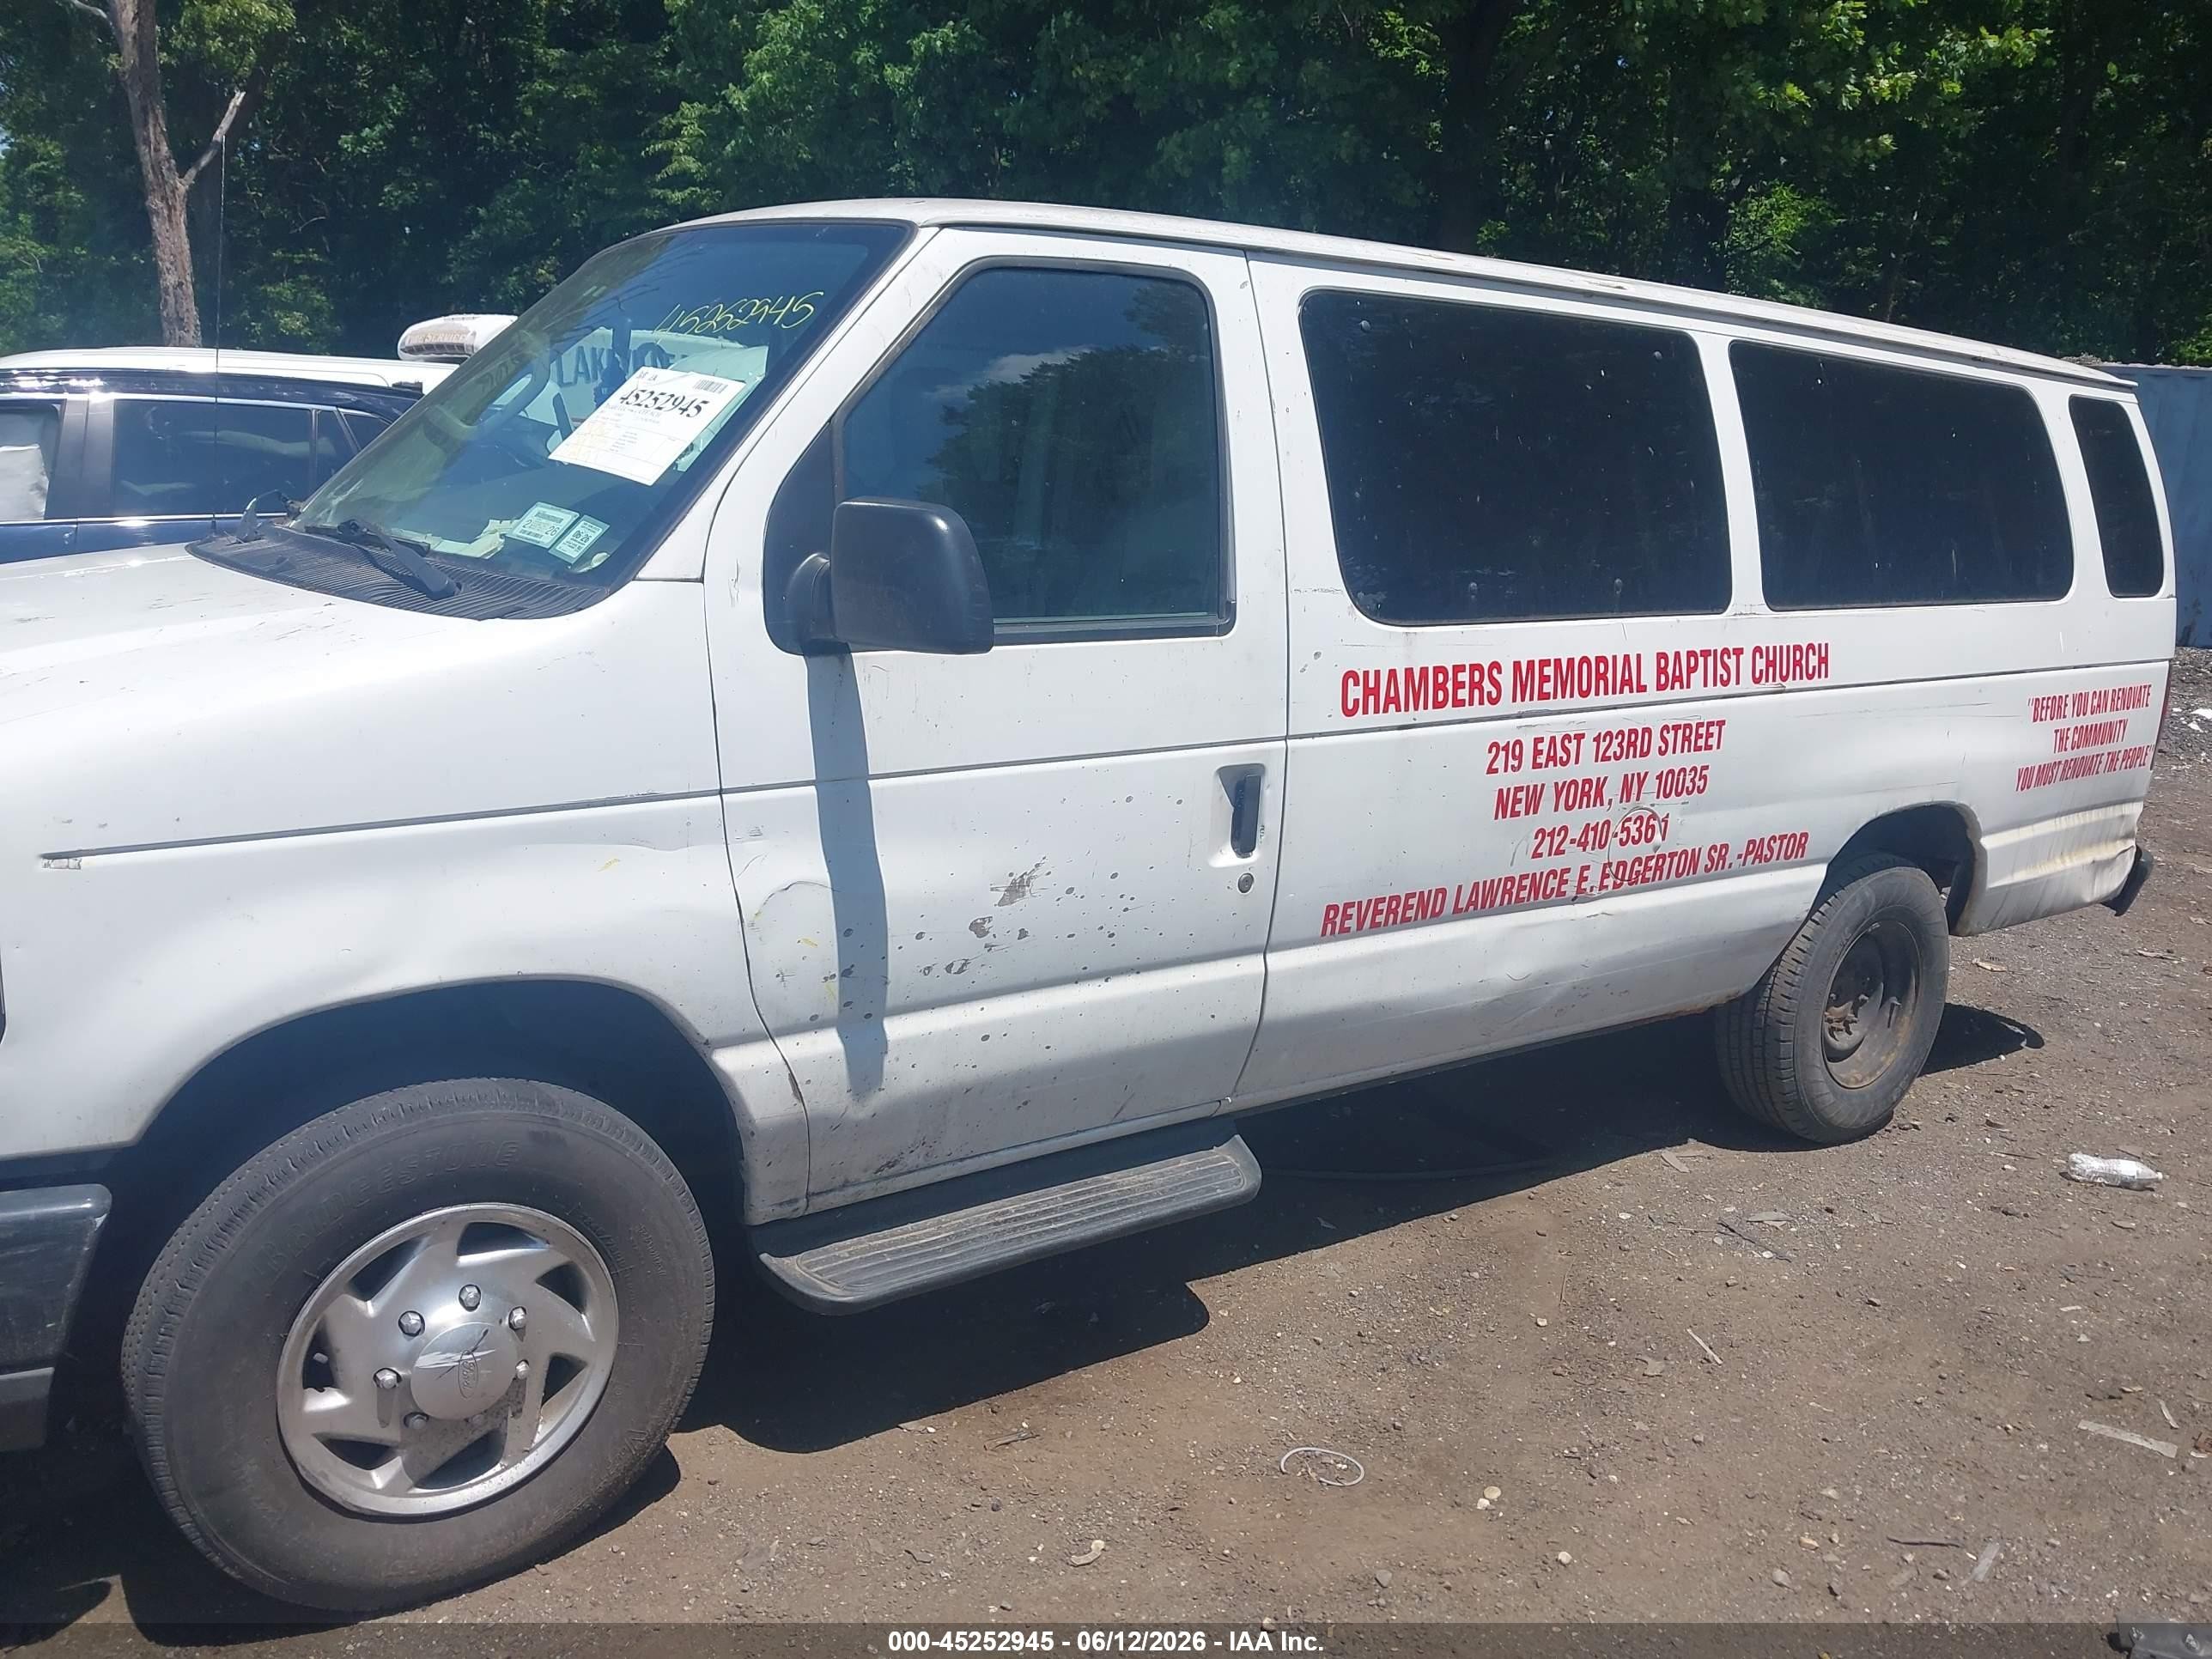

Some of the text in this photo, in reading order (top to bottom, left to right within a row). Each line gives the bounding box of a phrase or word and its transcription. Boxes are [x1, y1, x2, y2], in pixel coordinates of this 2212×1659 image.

[653, 291, 824, 344] 45252945
[619, 386, 710, 418] 45252945
[544, 526, 560, 537] 26
[1340, 642, 1829, 718] CHAMBERS MEMORIAL BAPTIST CHURCH
[2071, 691, 2090, 718] YOU
[2090, 689, 2110, 715] CAN
[2111, 684, 2152, 712] RENOVATE
[1486, 720, 1726, 775] 219 EAST 123RD STREET
[2053, 719, 2129, 754] THE COMMUNITY
[1494, 764, 1710, 820] NEW YORK, NY 10035
[2015, 765, 2036, 792] YOU
[2033, 760, 2063, 788] MUST
[2059, 753, 2105, 781] RENOVATE
[2103, 749, 2122, 774] THE
[1531, 812, 1670, 860] 212-410-5361
[1321, 886, 1448, 937] REVEREND
[1451, 866, 1571, 915] LAWRENCE
[1576, 865, 1594, 895] E.
[1598, 845, 1704, 891] EDGERTON
[1705, 842, 1733, 874] SR.
